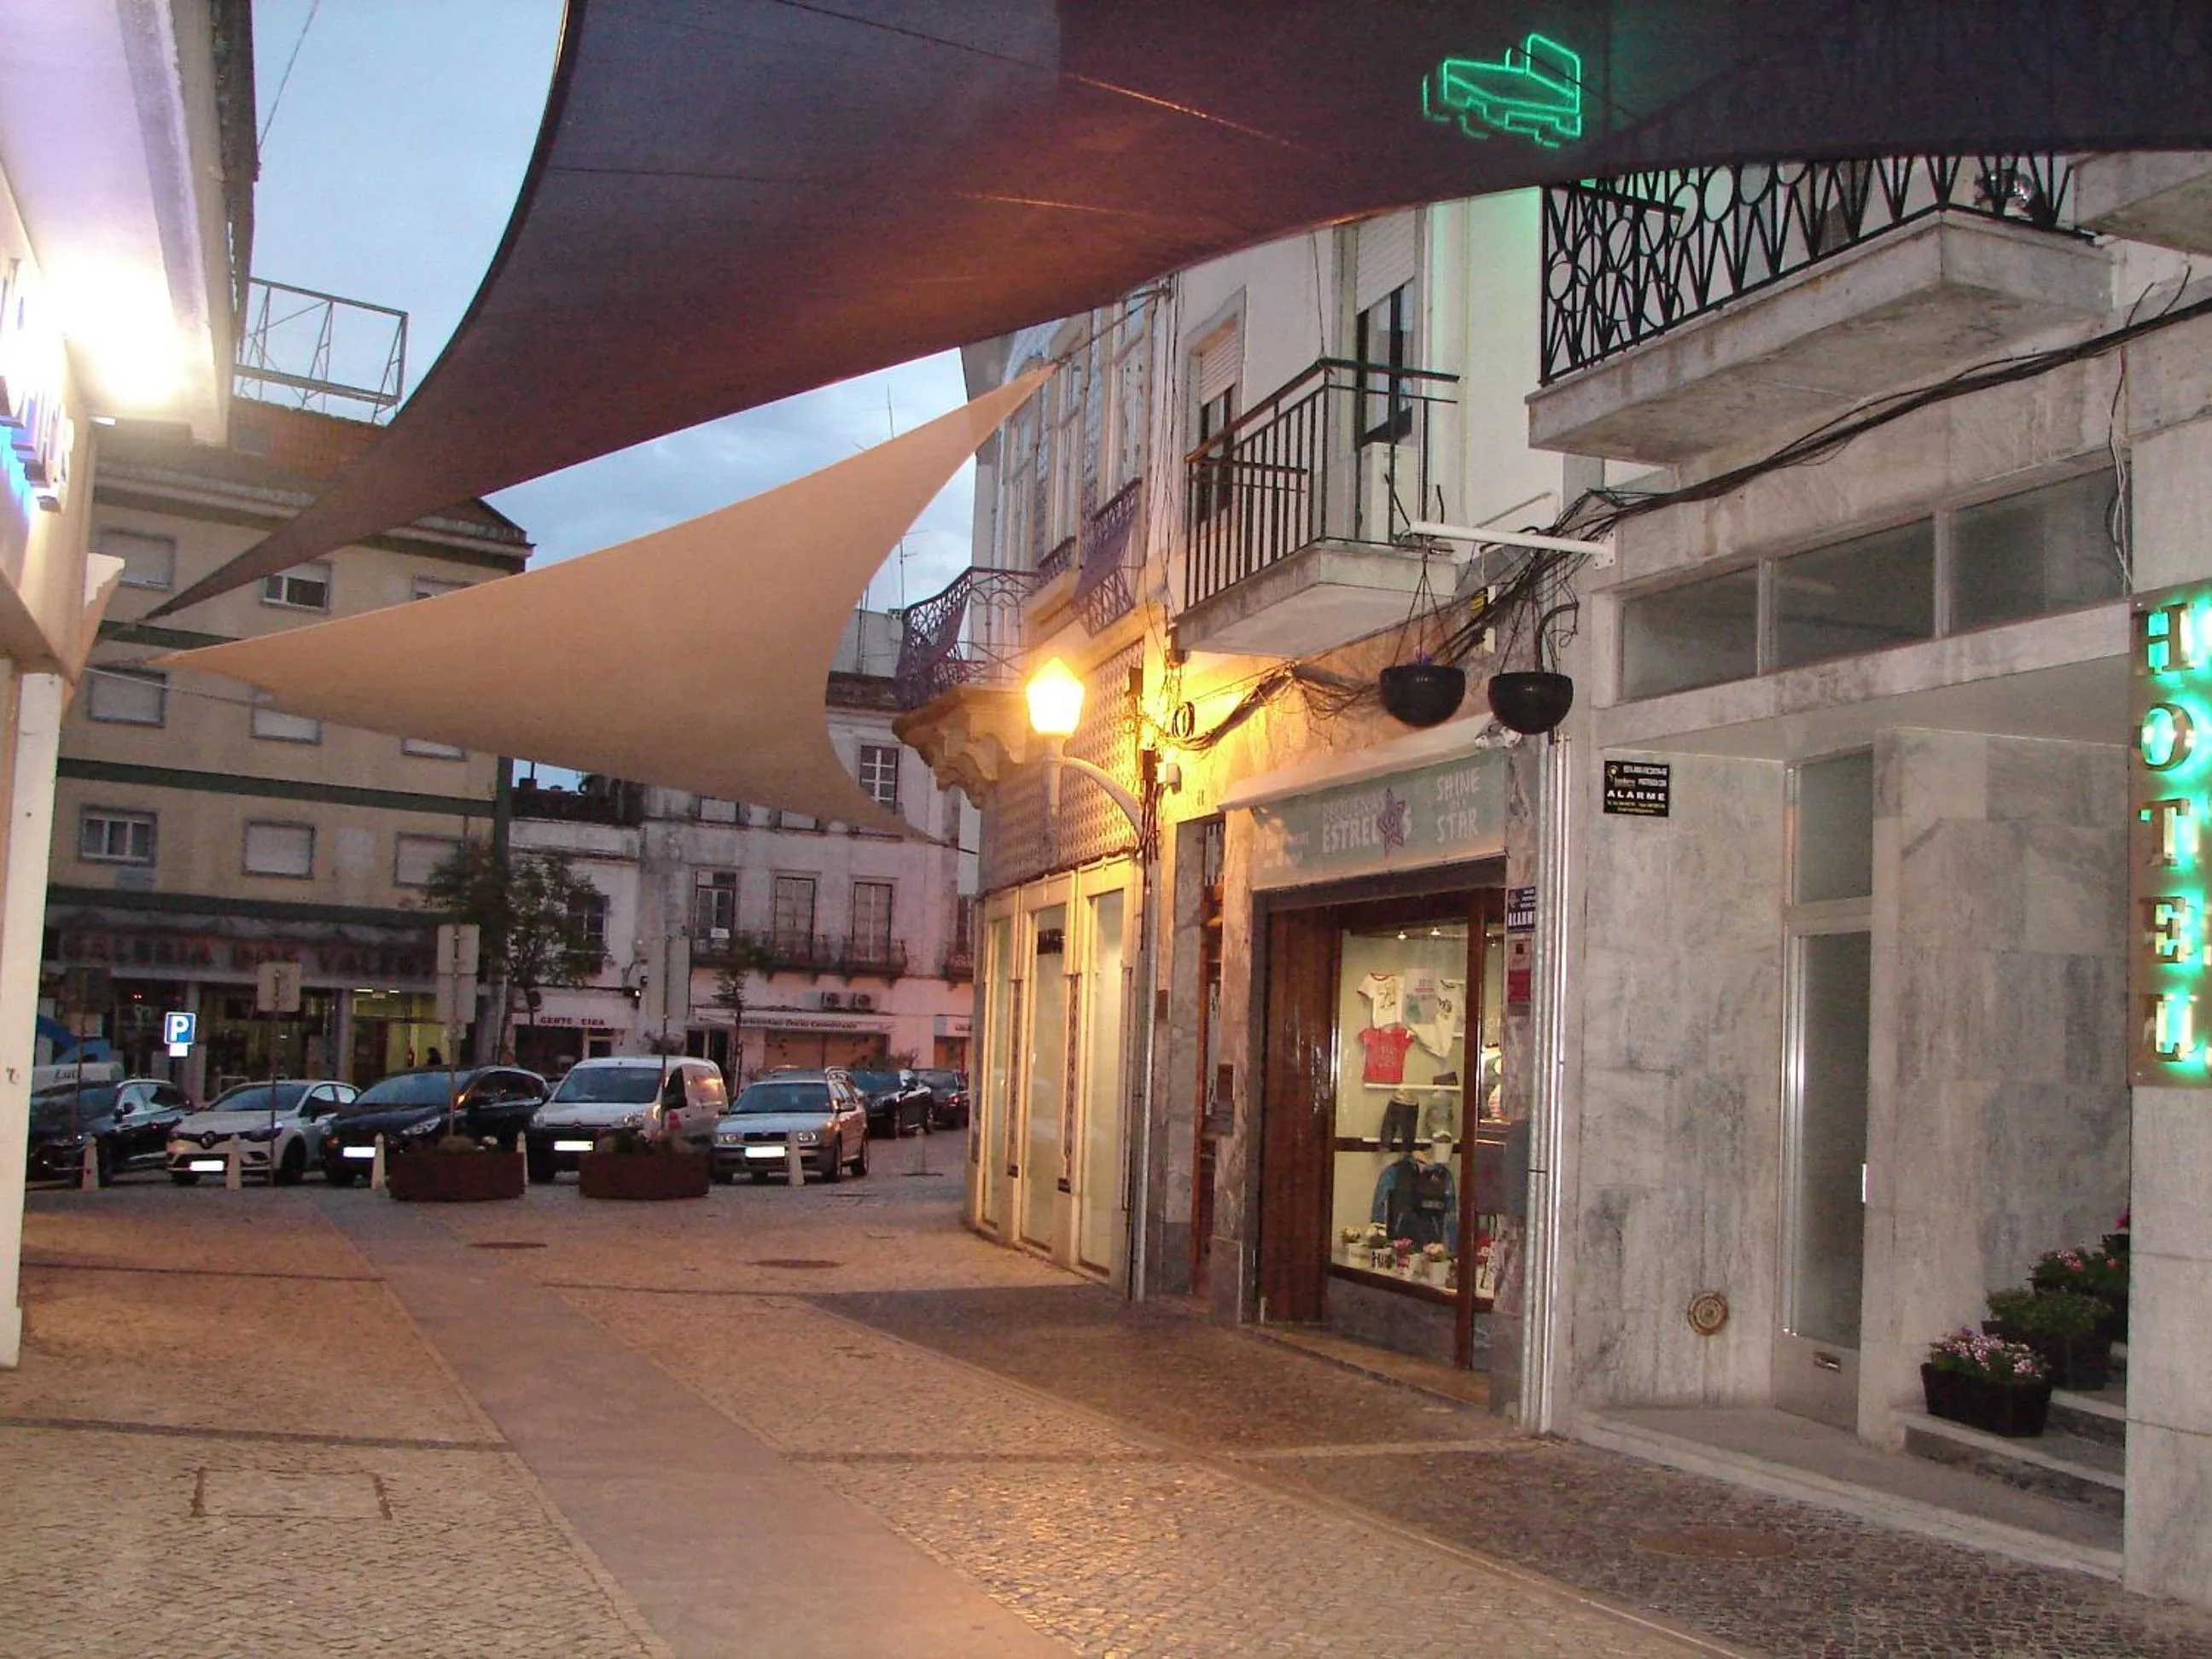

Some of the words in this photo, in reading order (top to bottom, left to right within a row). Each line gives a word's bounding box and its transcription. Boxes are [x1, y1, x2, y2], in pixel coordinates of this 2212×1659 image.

[1436, 767, 1481, 802] SHINE
[1607, 789, 1666, 801] ALARME
[1322, 806, 1412, 853] ESTRELS
[1437, 807, 1479, 843] STAR
[2135, 602, 2196, 1062] HOTEL
[1508, 911, 1535, 927] ALARM
[171, 1016, 189, 1042] P
